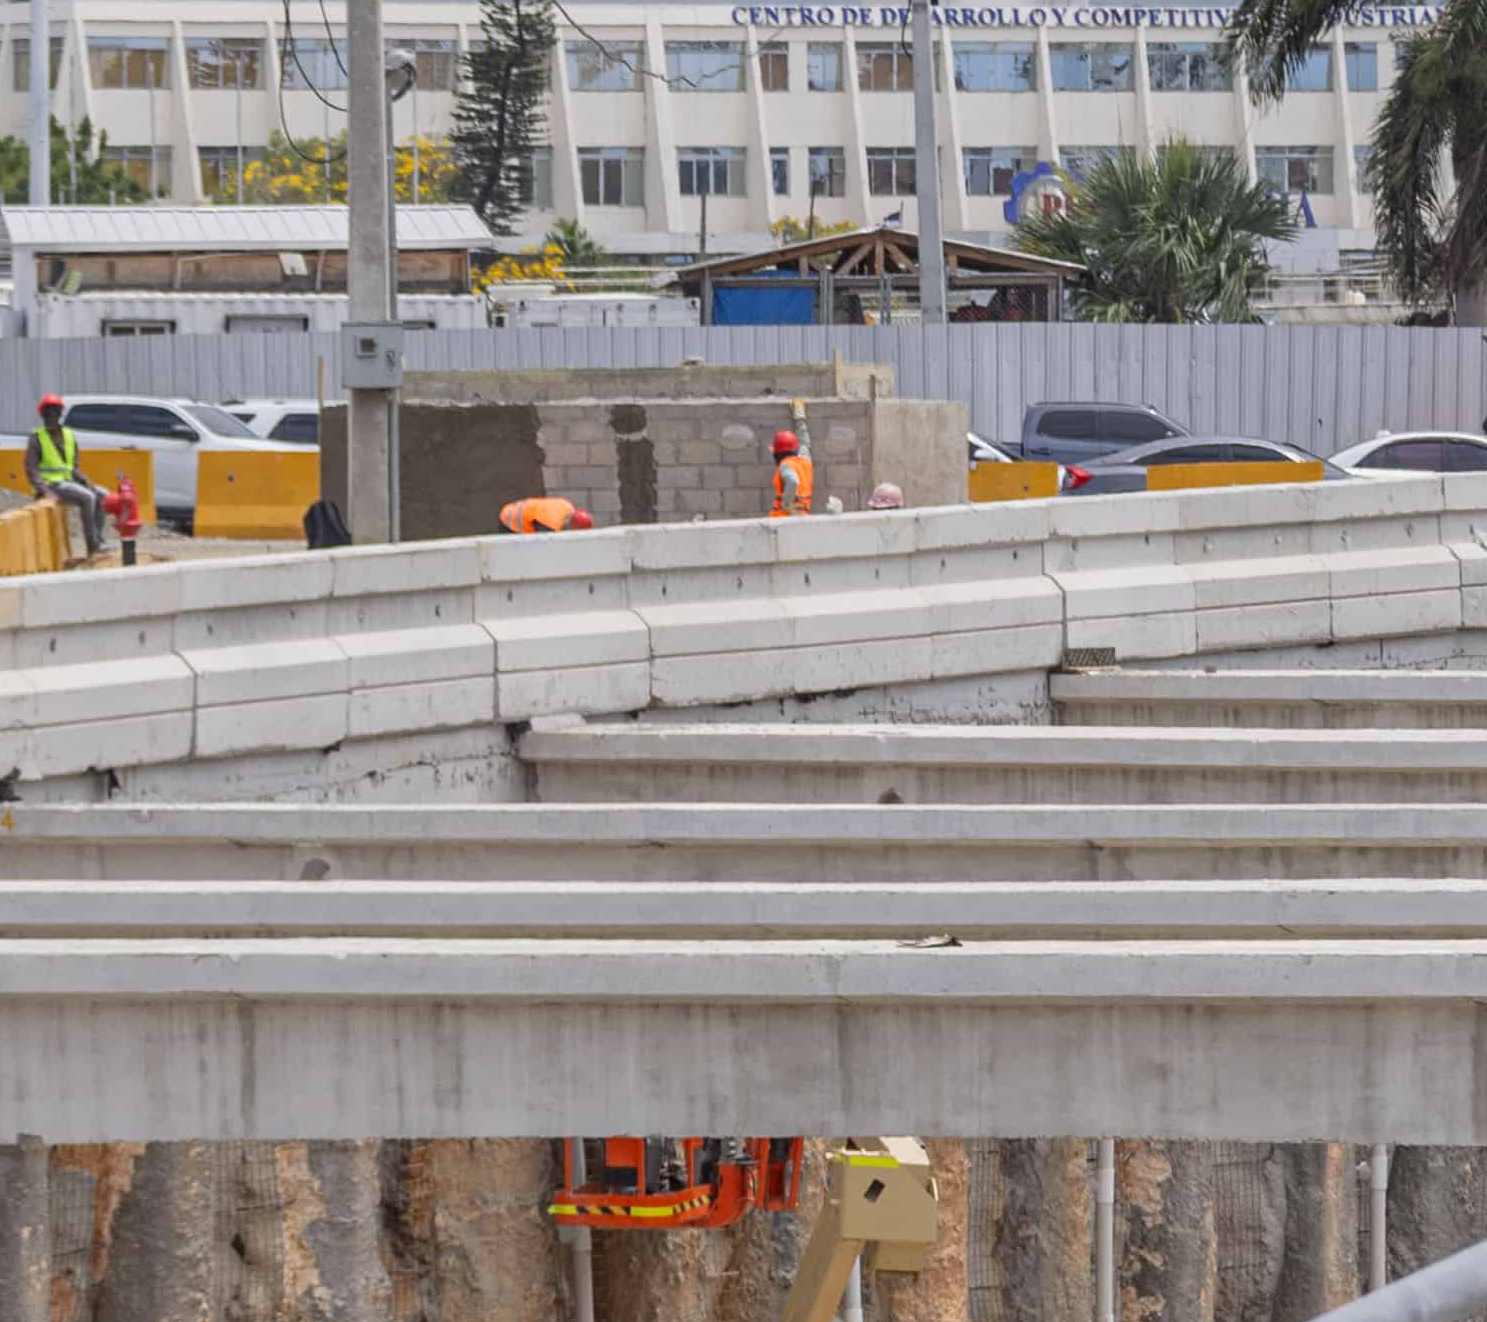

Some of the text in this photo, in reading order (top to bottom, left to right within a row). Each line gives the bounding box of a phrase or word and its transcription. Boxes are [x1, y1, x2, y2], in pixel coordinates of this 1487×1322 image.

[731, 6, 835, 25] CENTRO
[842, 7, 872, 25] DE
[880, 7, 1047, 26] DEARROLLO
[1052, 7, 1068, 26] Y
